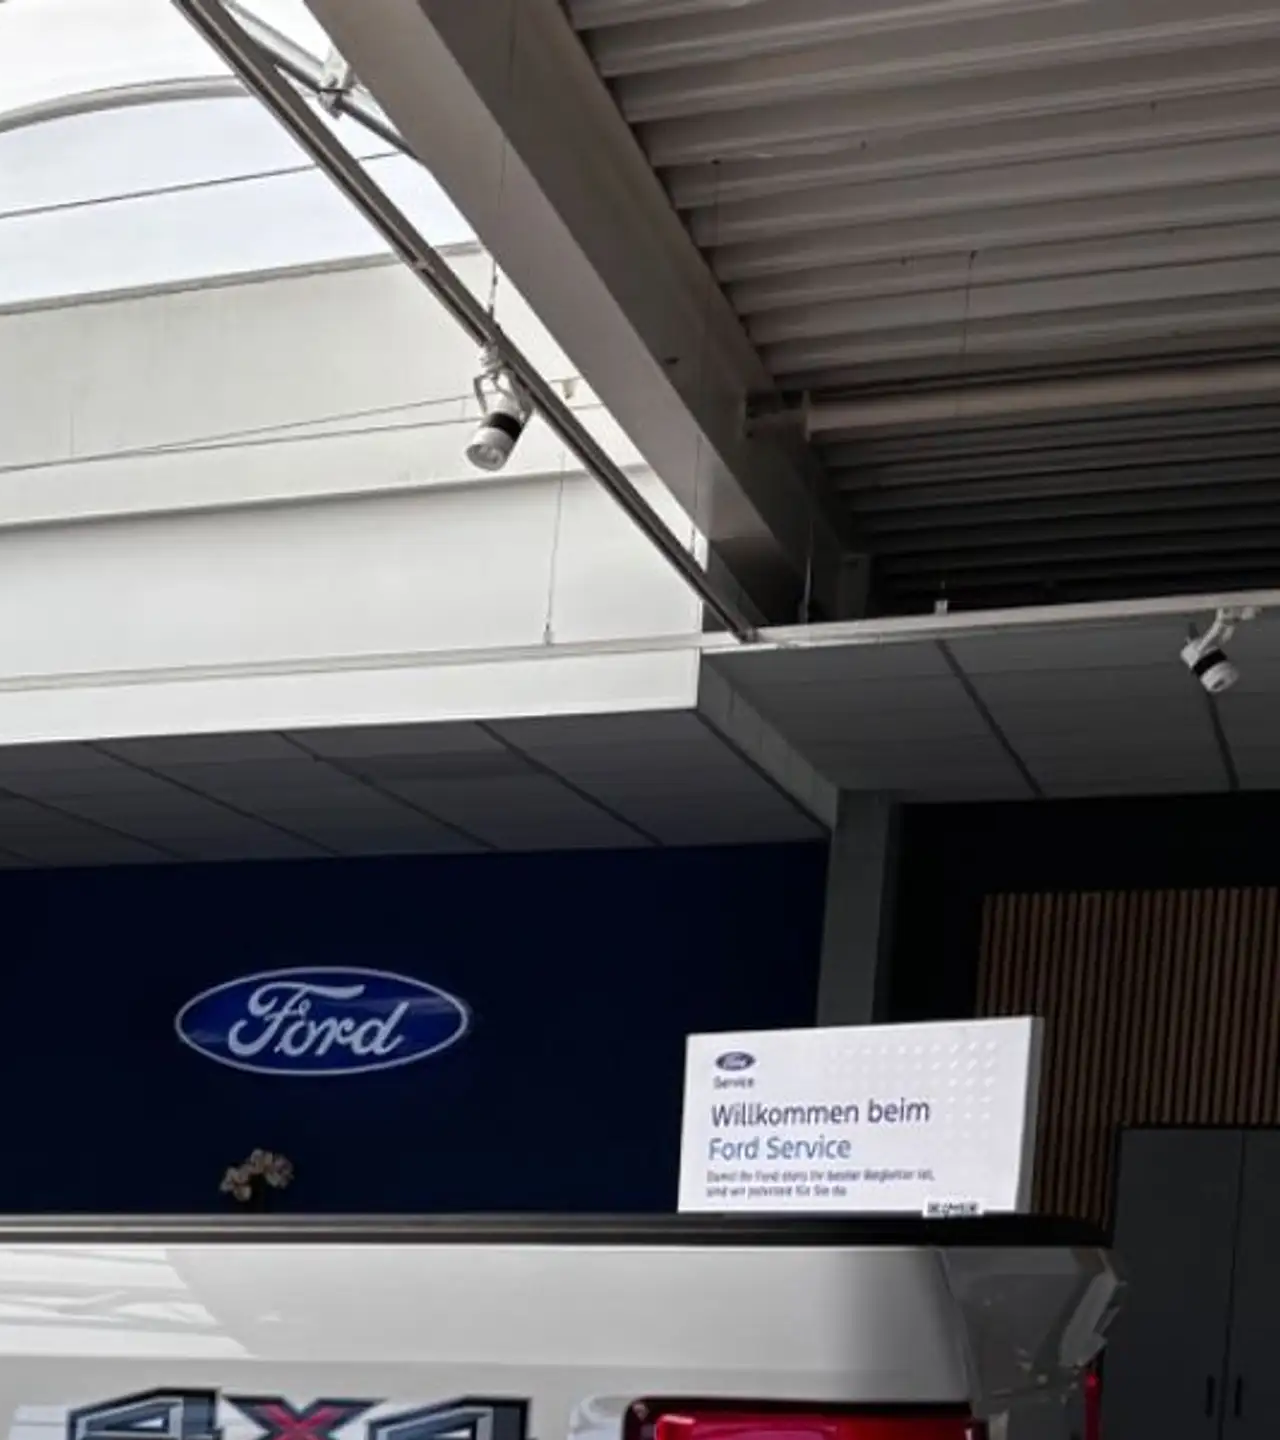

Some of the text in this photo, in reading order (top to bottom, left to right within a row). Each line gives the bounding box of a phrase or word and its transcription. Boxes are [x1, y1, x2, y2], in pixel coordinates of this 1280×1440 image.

[227, 980, 411, 1056] Ford
[710, 1097, 930, 1128] Willkommen beim
[707, 1133, 852, 1161] Ford Service
